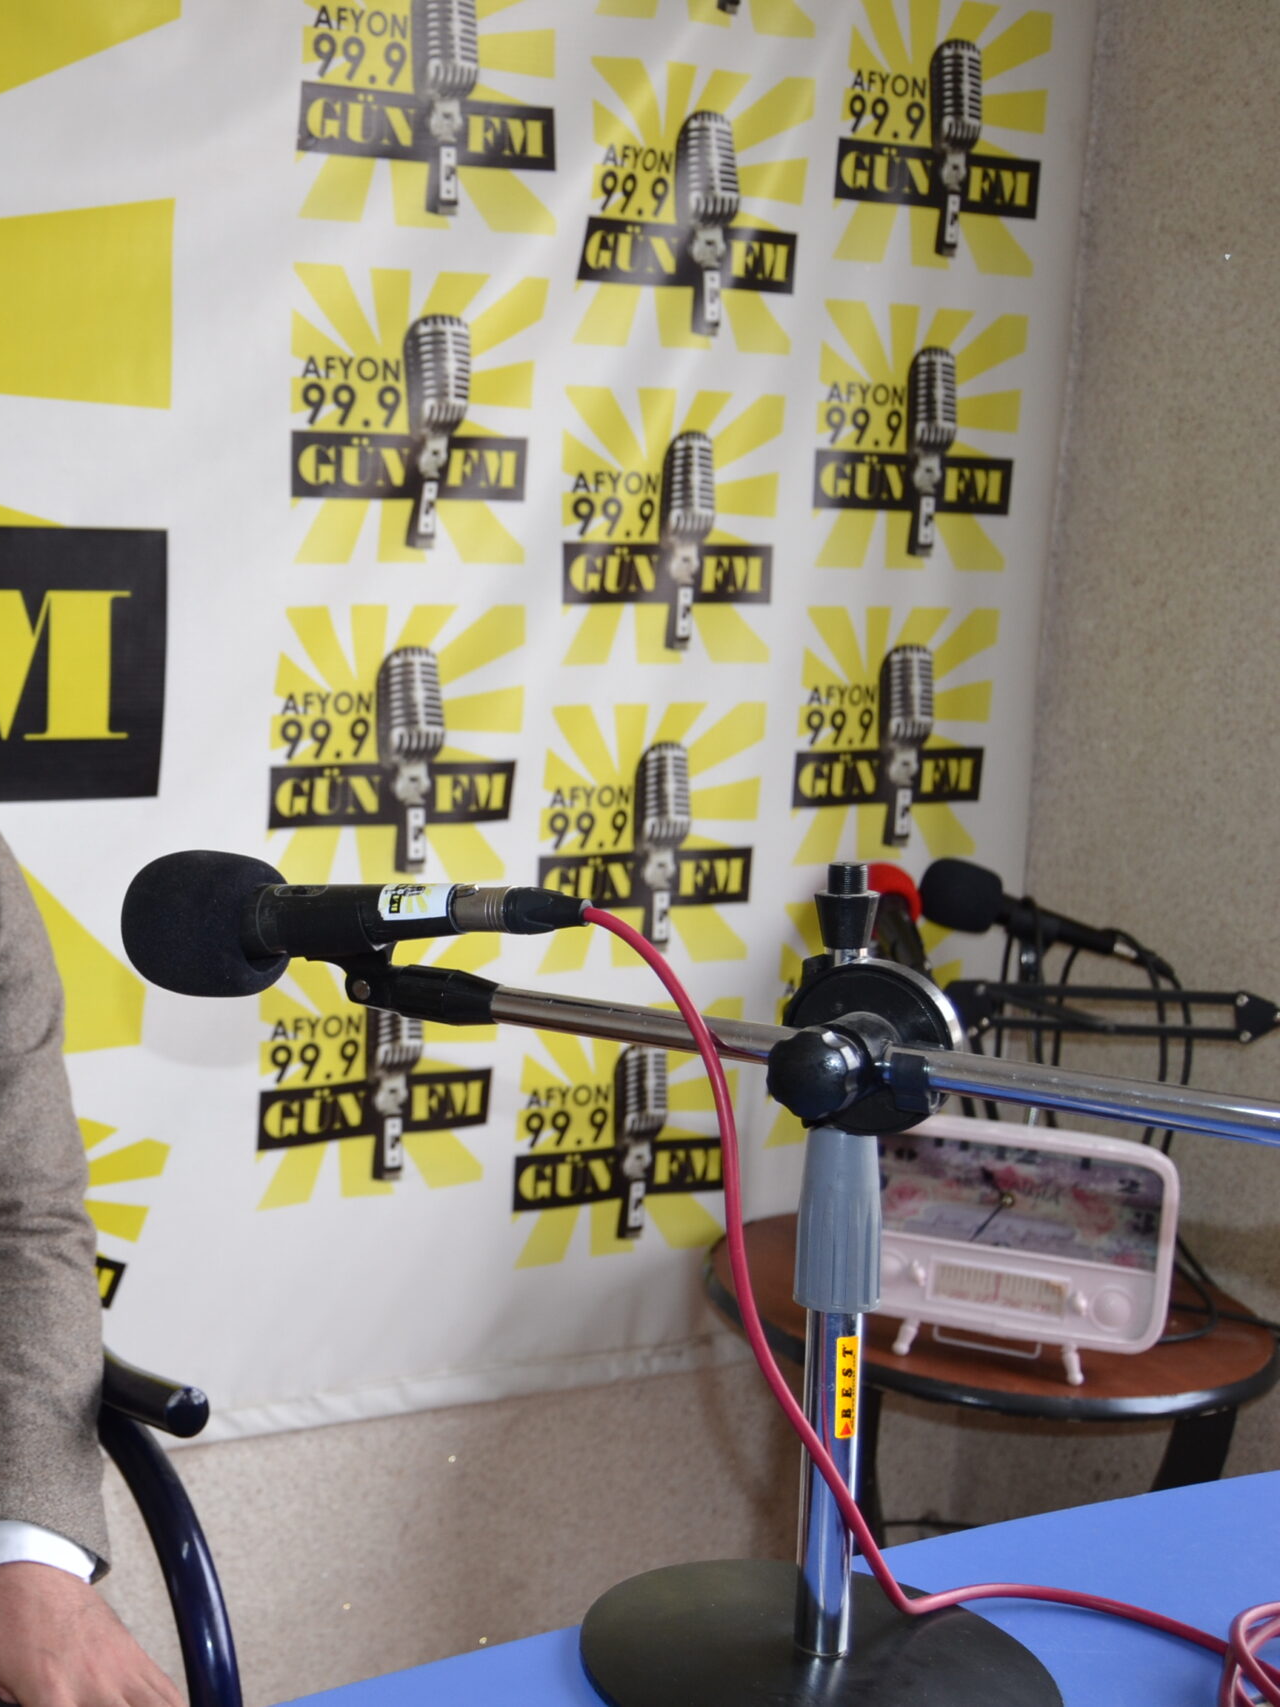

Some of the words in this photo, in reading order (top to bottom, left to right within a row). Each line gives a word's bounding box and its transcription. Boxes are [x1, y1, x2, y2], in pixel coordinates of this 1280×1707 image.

[313, 6, 408, 39] AFYON
[313, 34, 407, 86] 99.9
[851, 69, 926, 99] AFYON
[306, 93, 414, 147] GÜN
[467, 113, 547, 158] FM
[849, 94, 925, 140] 99.9
[602, 144, 672, 174] AFYON
[840, 148, 933, 196] GÜN
[967, 165, 1031, 207] FM
[600, 171, 669, 217] 99.9
[585, 226, 678, 275] GÜN
[730, 239, 791, 283] FM
[302, 356, 400, 382] AFYON
[302, 383, 401, 429] 99.9
[827, 382, 905, 406] AFYON
[825, 406, 903, 447] 99.9
[298, 437, 410, 488] GÜN
[447, 448, 518, 489] FM
[573, 471, 659, 495] AFYON
[820, 455, 906, 500] GÜN
[944, 466, 1003, 504] FM
[572, 497, 655, 538] 99.9
[569, 547, 658, 594] GÜN
[701, 555, 764, 593] FM
[282, 692, 374, 715] AFYON
[808, 684, 875, 707] AFYON
[281, 718, 369, 760] 99.9
[806, 709, 873, 747] 99.9
[275, 768, 380, 818] GÜN
[434, 773, 509, 813] FM
[797, 753, 880, 798] GÜN
[921, 757, 975, 793] FM
[549, 785, 632, 810] AFYON
[549, 809, 628, 850] 99.9
[679, 858, 745, 896] FM
[271, 1014, 364, 1042] AFYON
[271, 1040, 359, 1084] 99.9
[264, 1089, 366, 1139] GÜN
[410, 1080, 484, 1121] FM
[527, 1083, 610, 1110] AFYON
[525, 1107, 608, 1148] 99.9
[519, 1155, 615, 1201] GÜN
[653, 1149, 721, 1185] FM
[841, 1343, 854, 1420] BEST
